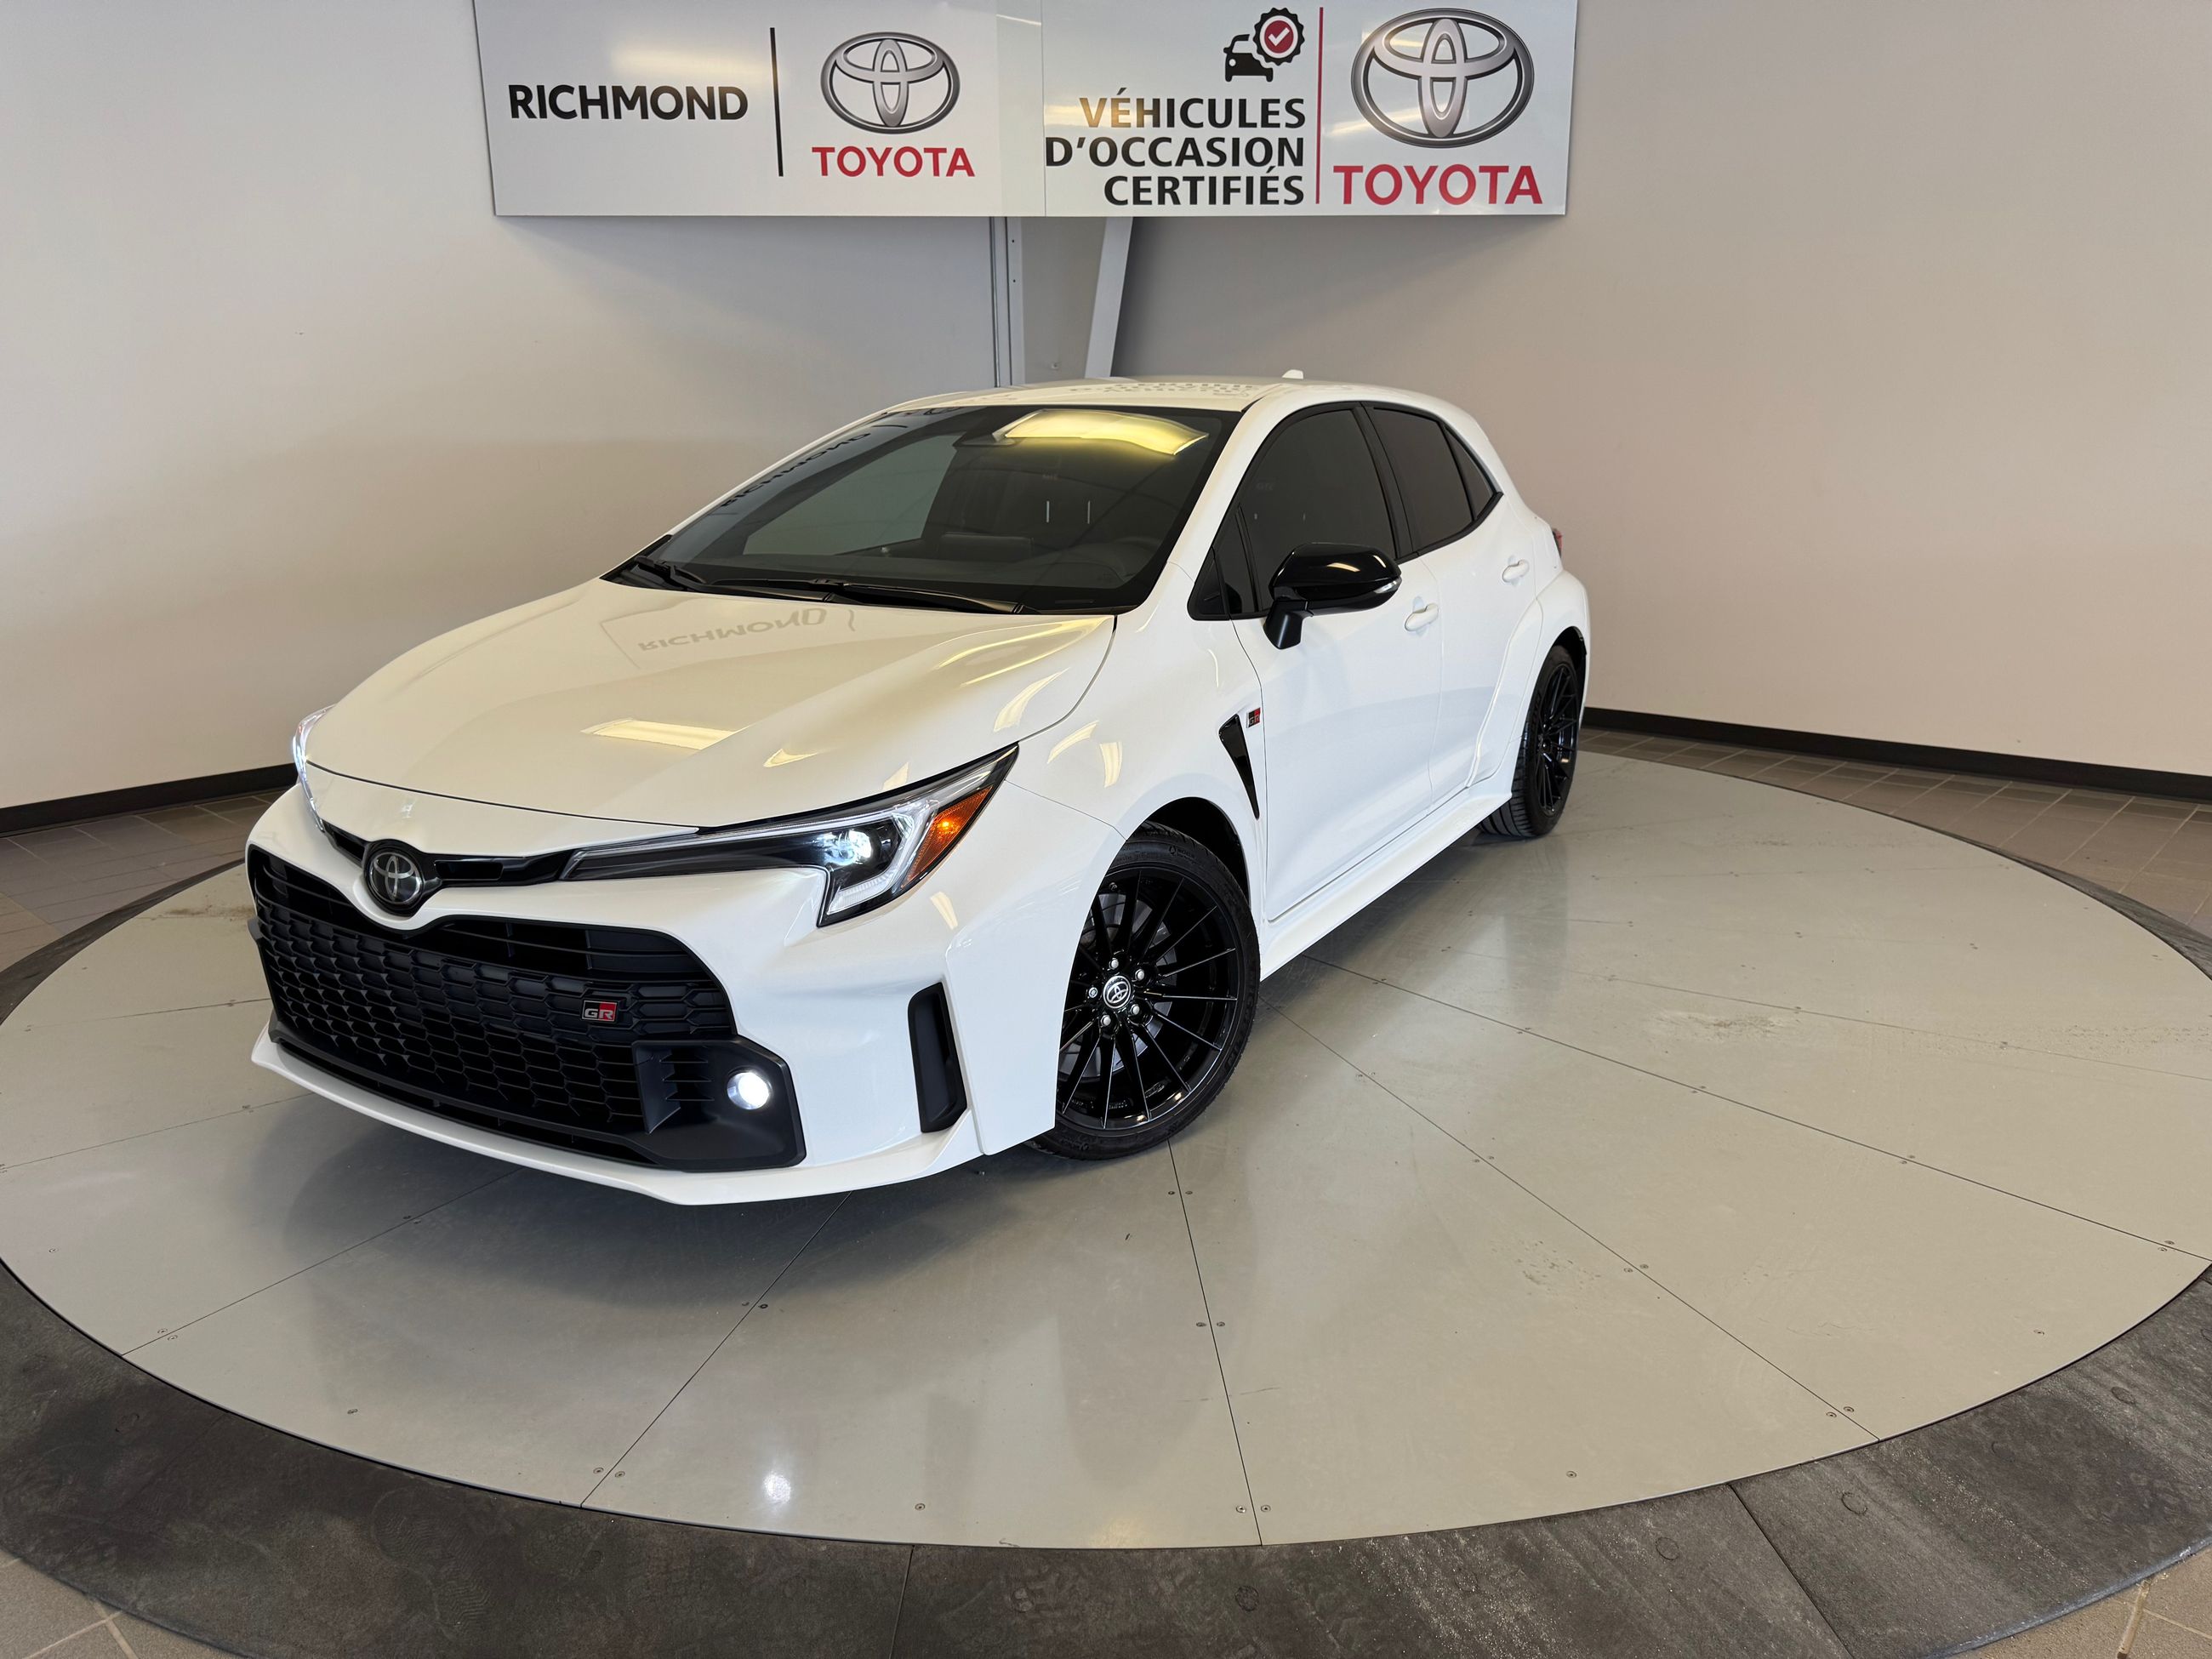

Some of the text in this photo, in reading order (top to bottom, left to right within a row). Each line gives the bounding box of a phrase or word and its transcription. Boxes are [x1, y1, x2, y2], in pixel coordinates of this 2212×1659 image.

[508, 84, 749, 120] RICHMOND
[1079, 87, 1306, 128] VÉHICULES
[811, 145, 975, 178] TOYOTA
[1045, 136, 1304, 167] D'OCCASION
[1103, 165, 1304, 206] CERTIFIÉS
[1333, 163, 1543, 205] TOYOTA
[584, 1007, 614, 1020] GR
